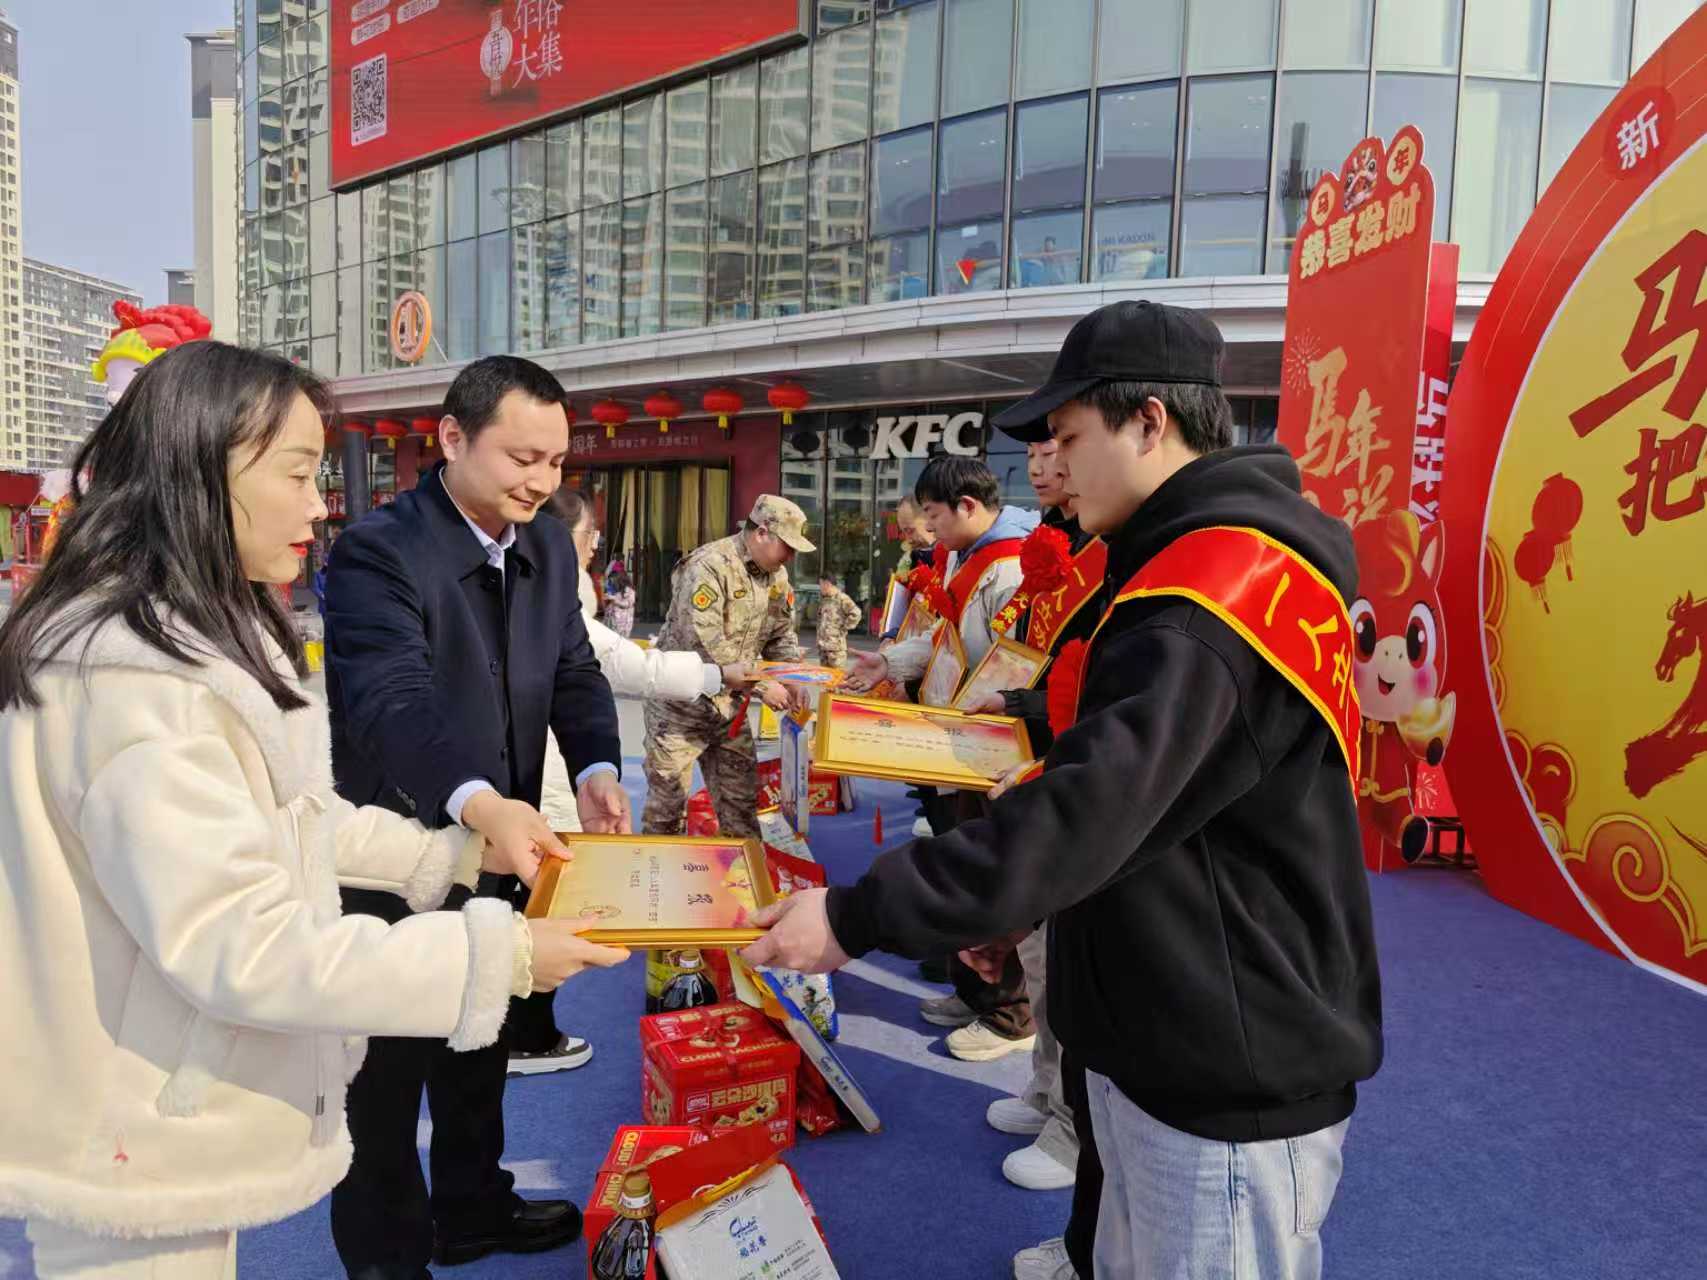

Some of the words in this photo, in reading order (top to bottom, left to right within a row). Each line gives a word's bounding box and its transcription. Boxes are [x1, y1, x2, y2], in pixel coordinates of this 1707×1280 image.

[512, 31, 564, 88] 大集
[1616, 100, 1660, 170] 新
[868, 411, 984, 459] KFC
